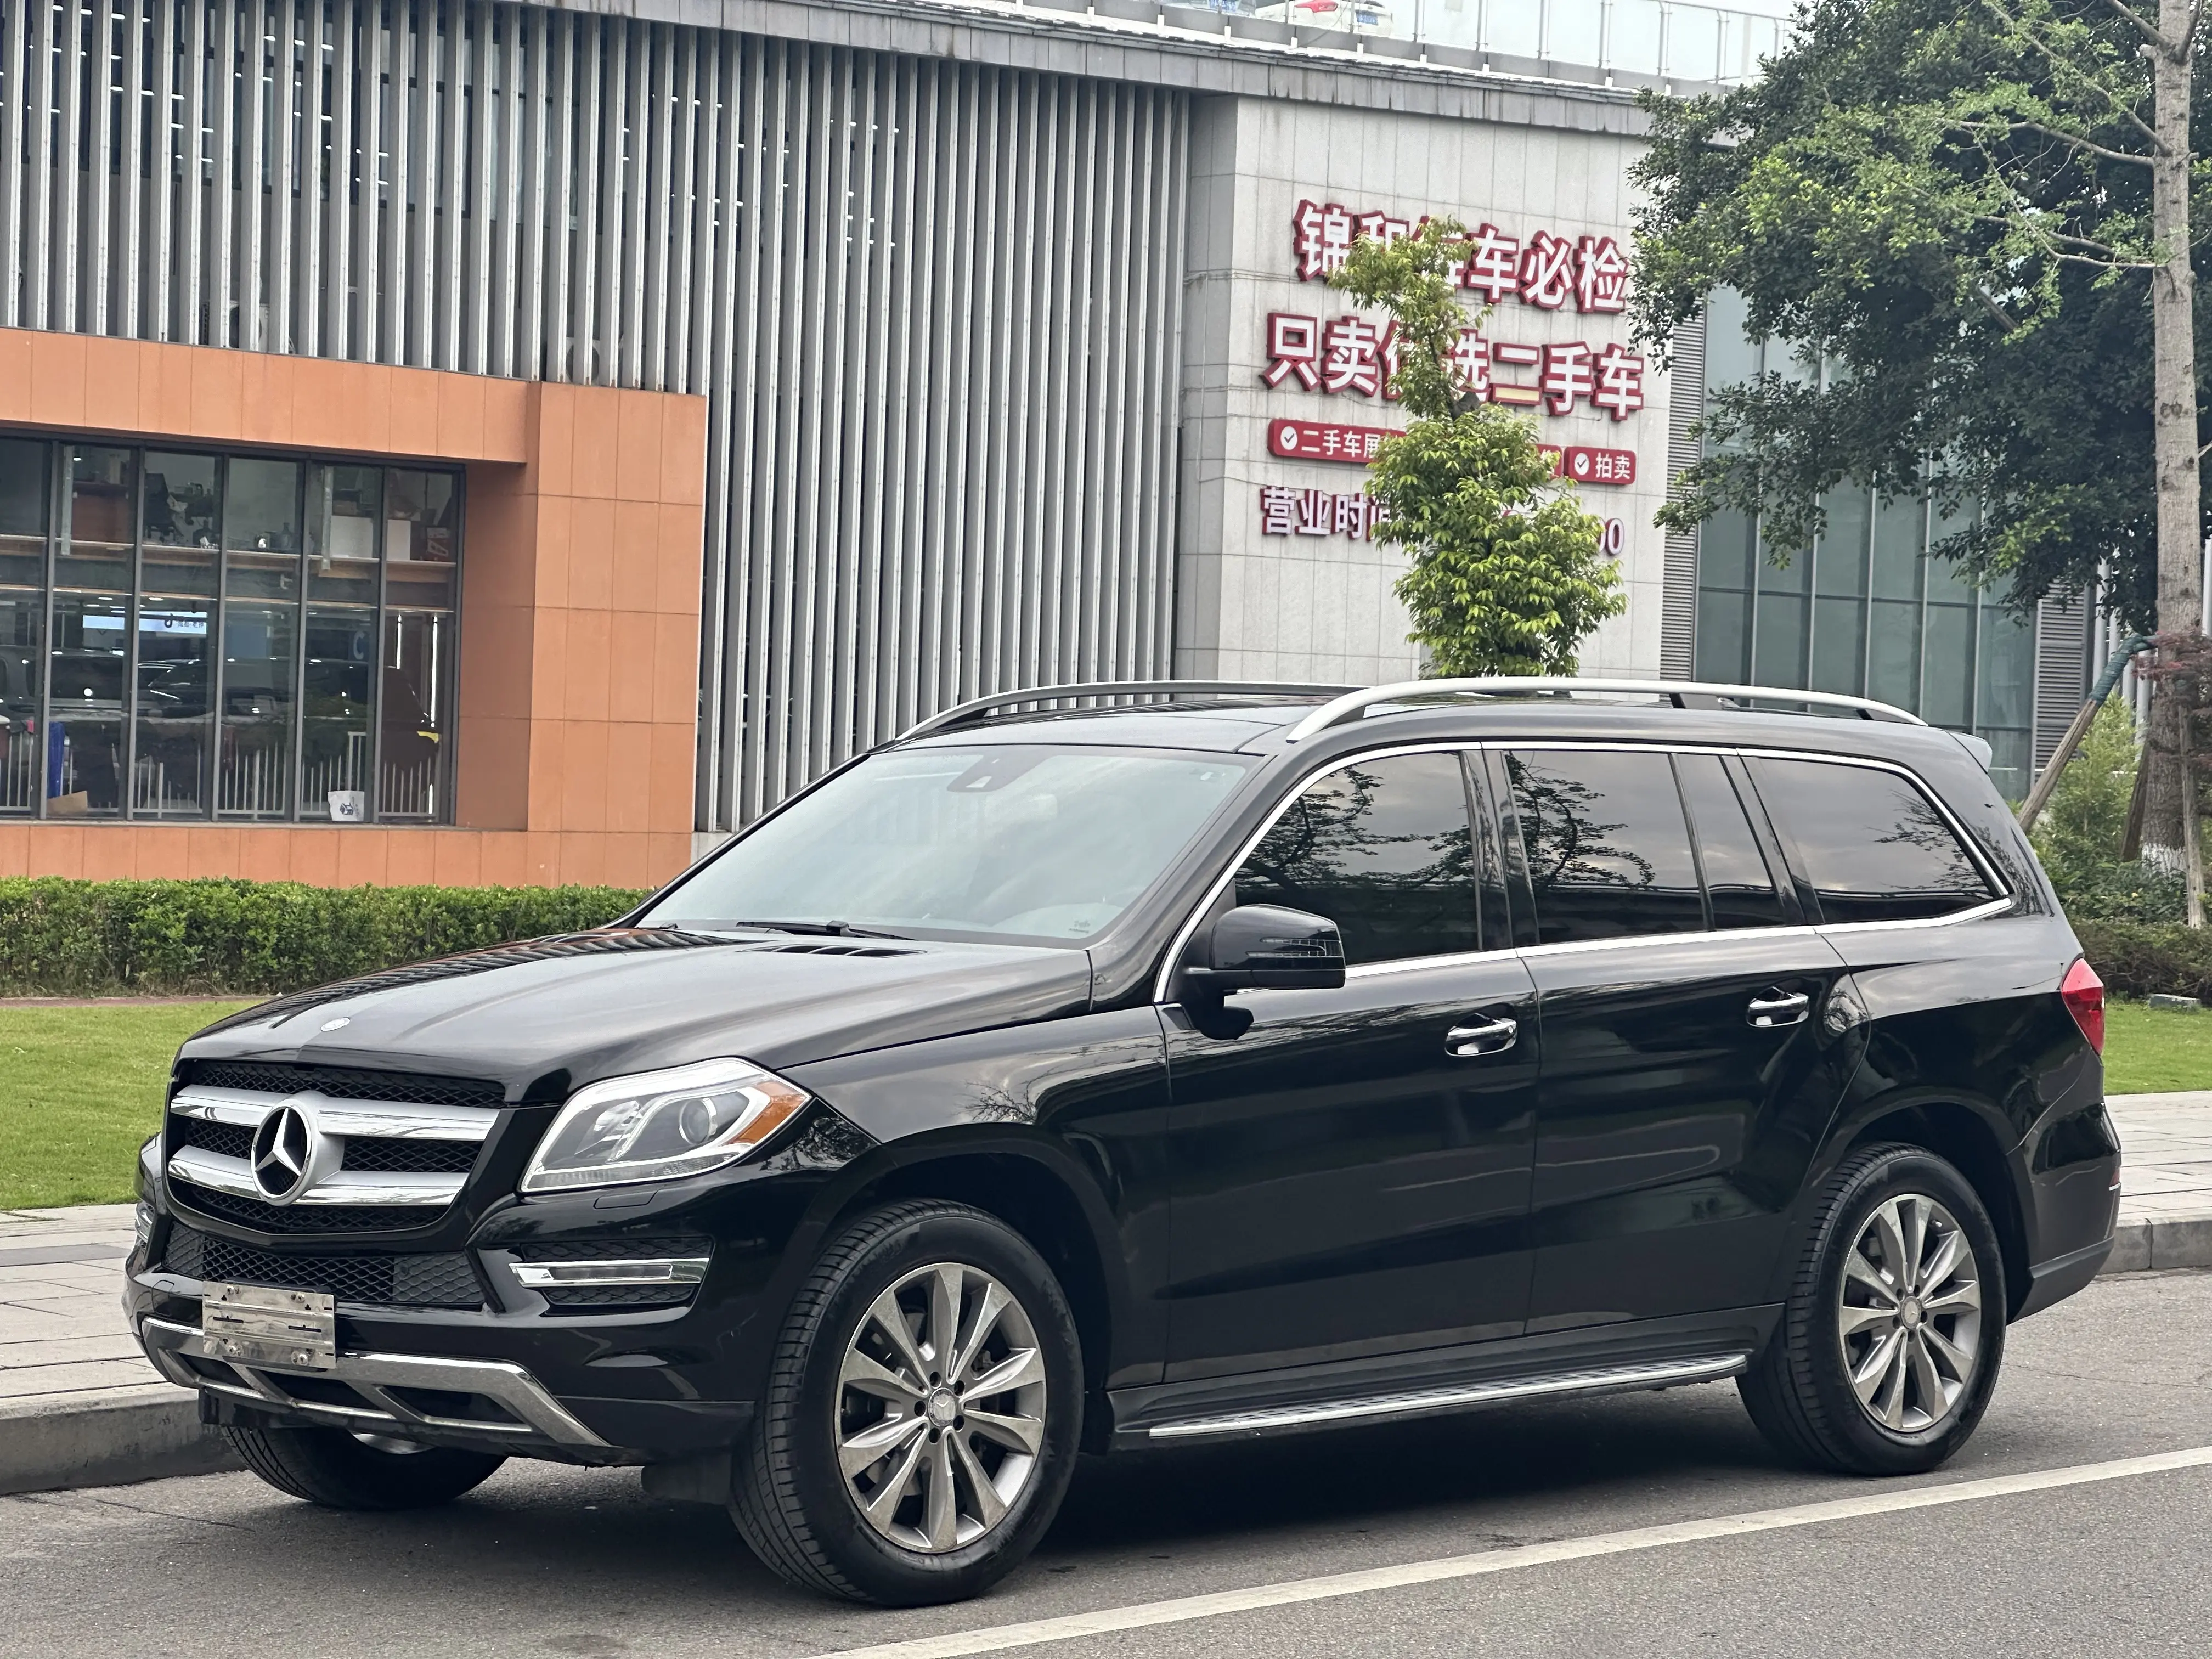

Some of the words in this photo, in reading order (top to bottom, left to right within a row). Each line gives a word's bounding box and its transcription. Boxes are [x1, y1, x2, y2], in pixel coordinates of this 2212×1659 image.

[1301, 429, 1399, 460] 二手车展
[1595, 452, 1631, 480] 拍卖
